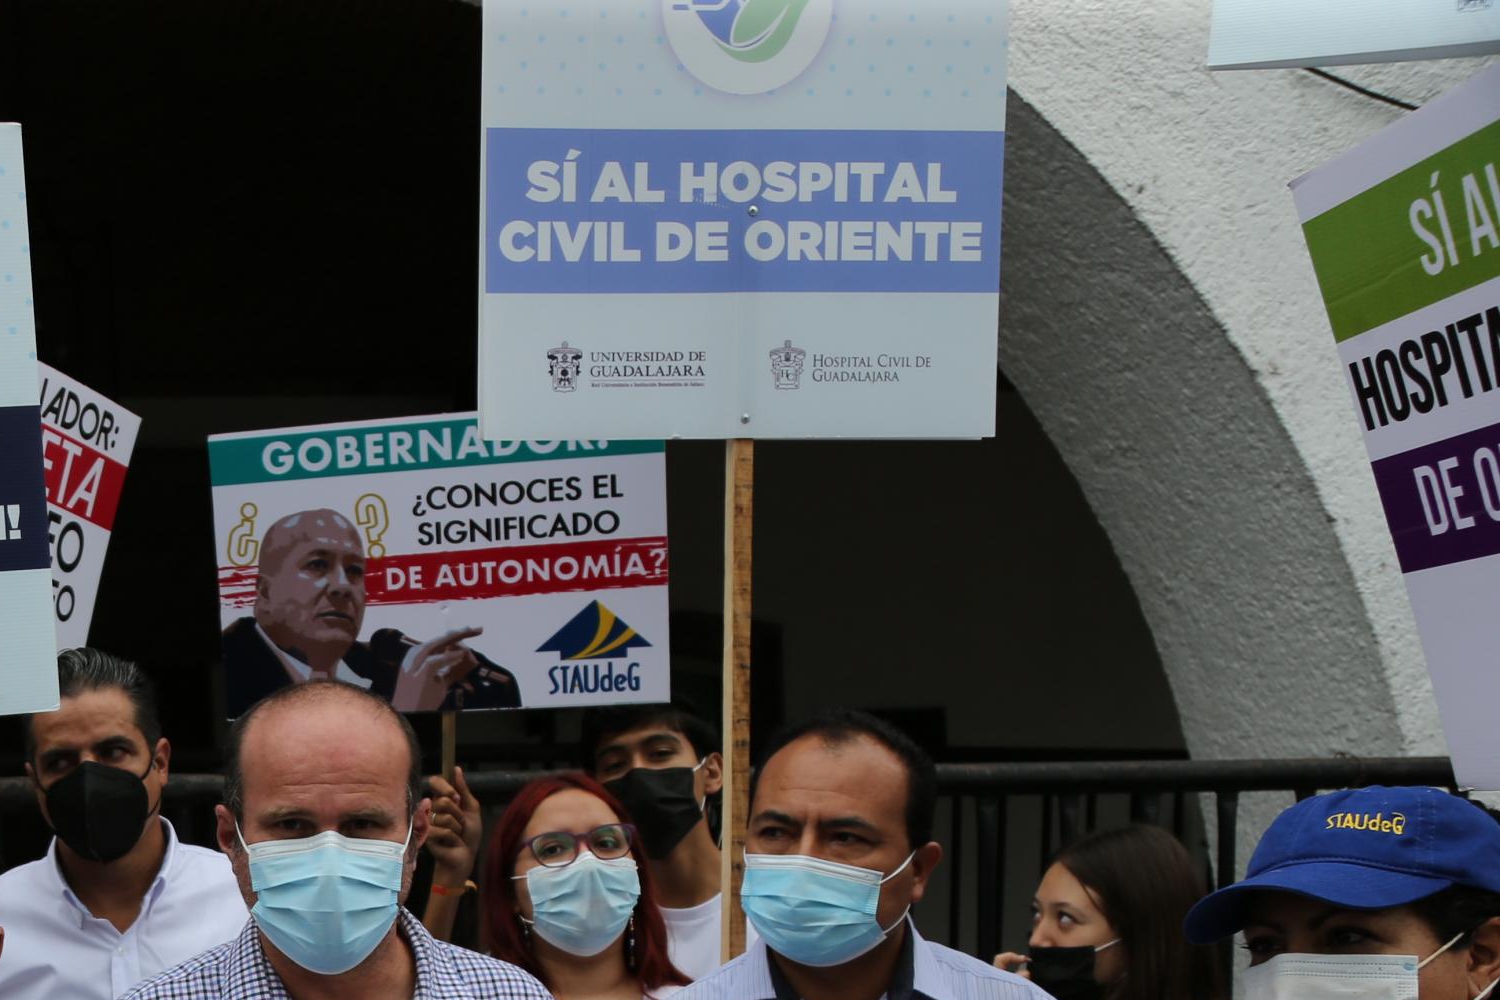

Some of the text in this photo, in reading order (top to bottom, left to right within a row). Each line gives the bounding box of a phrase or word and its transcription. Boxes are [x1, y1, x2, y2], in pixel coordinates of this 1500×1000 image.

[525, 149, 957, 204] SÍ AL HOSPITAL
[499, 220, 983, 263] CIVIL DE ORIENTE
[1409, 170, 1460, 276] SÍ
[590, 351, 707, 363] UNIVERSIDAD DE
[590, 365, 706, 378] GUADALAJARA
[915, 356, 932, 368] DE
[40, 378, 120, 451] ADOR:
[411, 474, 624, 518] ¿CONOCES EL
[1413, 455, 1476, 537] DE
[417, 509, 621, 548] SIGNIFICADO
[386, 545, 668, 591] DE AUTONOMÍA?
[548, 661, 641, 696] STAUdeG
[1325, 811, 1406, 835] STAUdeG
